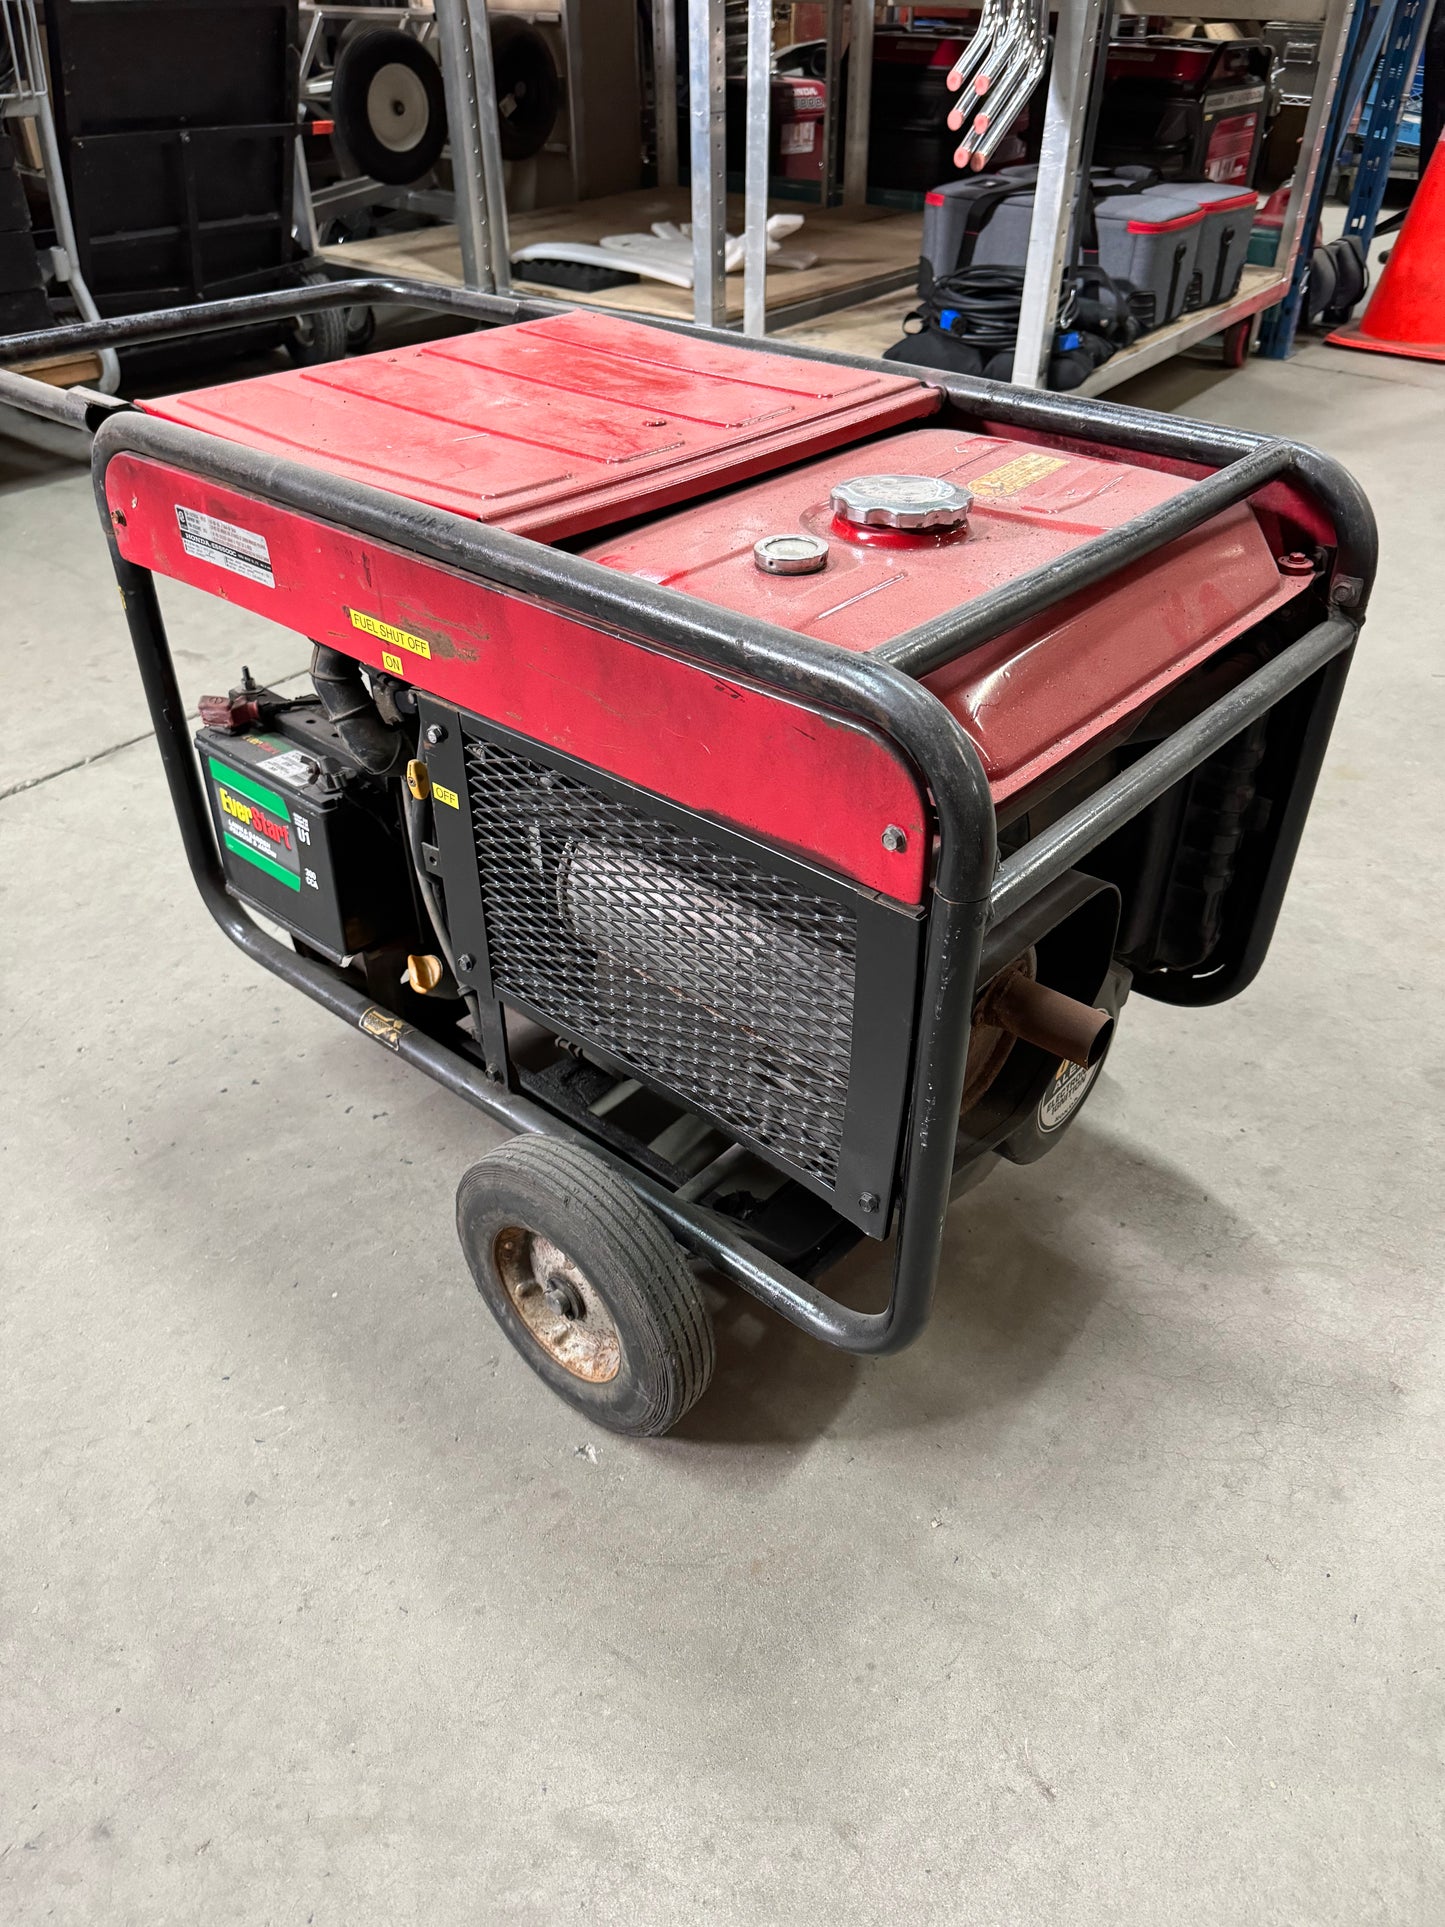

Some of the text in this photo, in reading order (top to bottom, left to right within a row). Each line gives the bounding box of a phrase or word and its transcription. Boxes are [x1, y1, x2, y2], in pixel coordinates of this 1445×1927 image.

[353, 613, 427, 654] FUEL SHUT OFF
[385, 655, 401, 671] ON
[435, 786, 456, 804] OFF
[219, 787, 292, 851] EverStart
[296, 826, 311, 846] U1
[1046, 1068, 1087, 1113] ELECTRON
